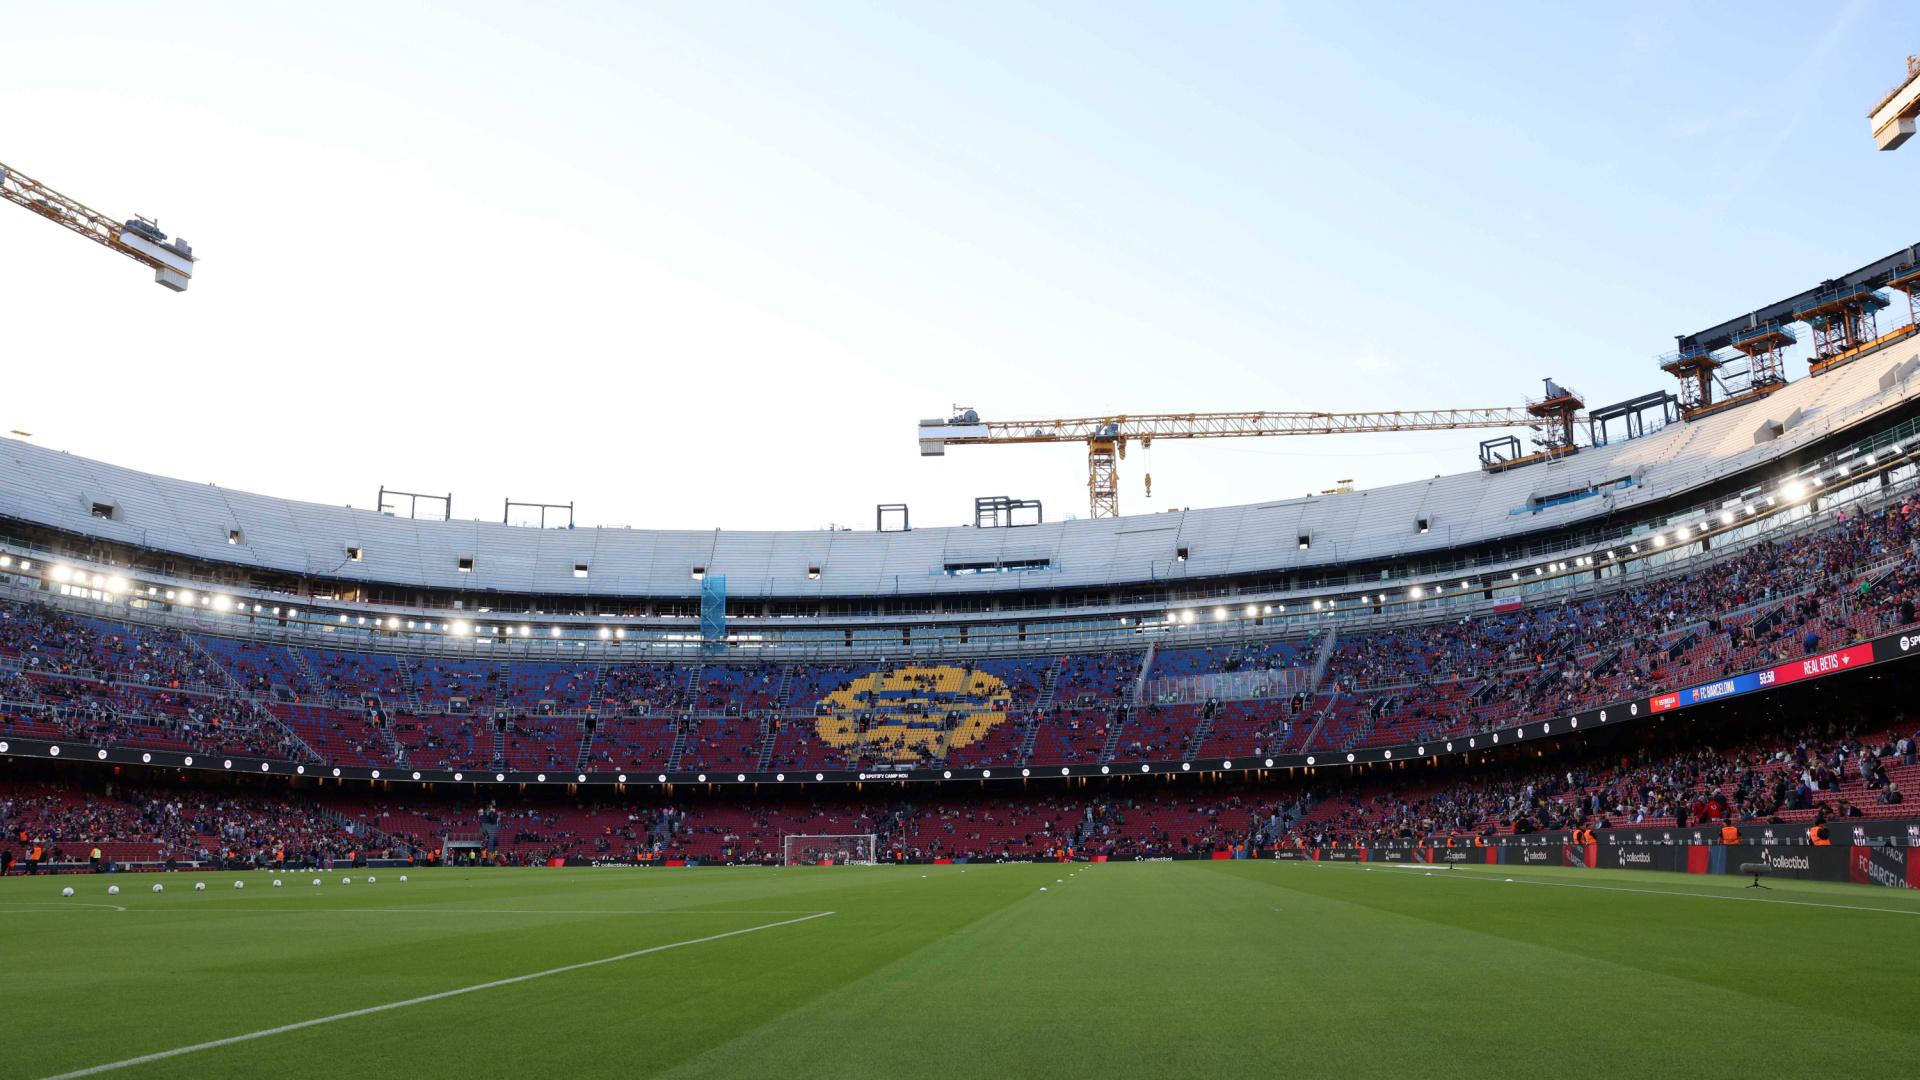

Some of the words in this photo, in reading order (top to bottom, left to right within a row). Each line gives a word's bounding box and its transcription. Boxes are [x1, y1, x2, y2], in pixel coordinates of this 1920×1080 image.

[1910, 634, 1920, 647] SP
[1803, 660, 1819, 675] REAL
[1819, 653, 1839, 671] BETIS
[1700, 686, 1707, 699] FC
[1707, 680, 1735, 698] BARCELONA
[1626, 852, 1651, 863] collectibol
[1772, 855, 1810, 870] collectibol
[1859, 855, 1868, 873] FC
